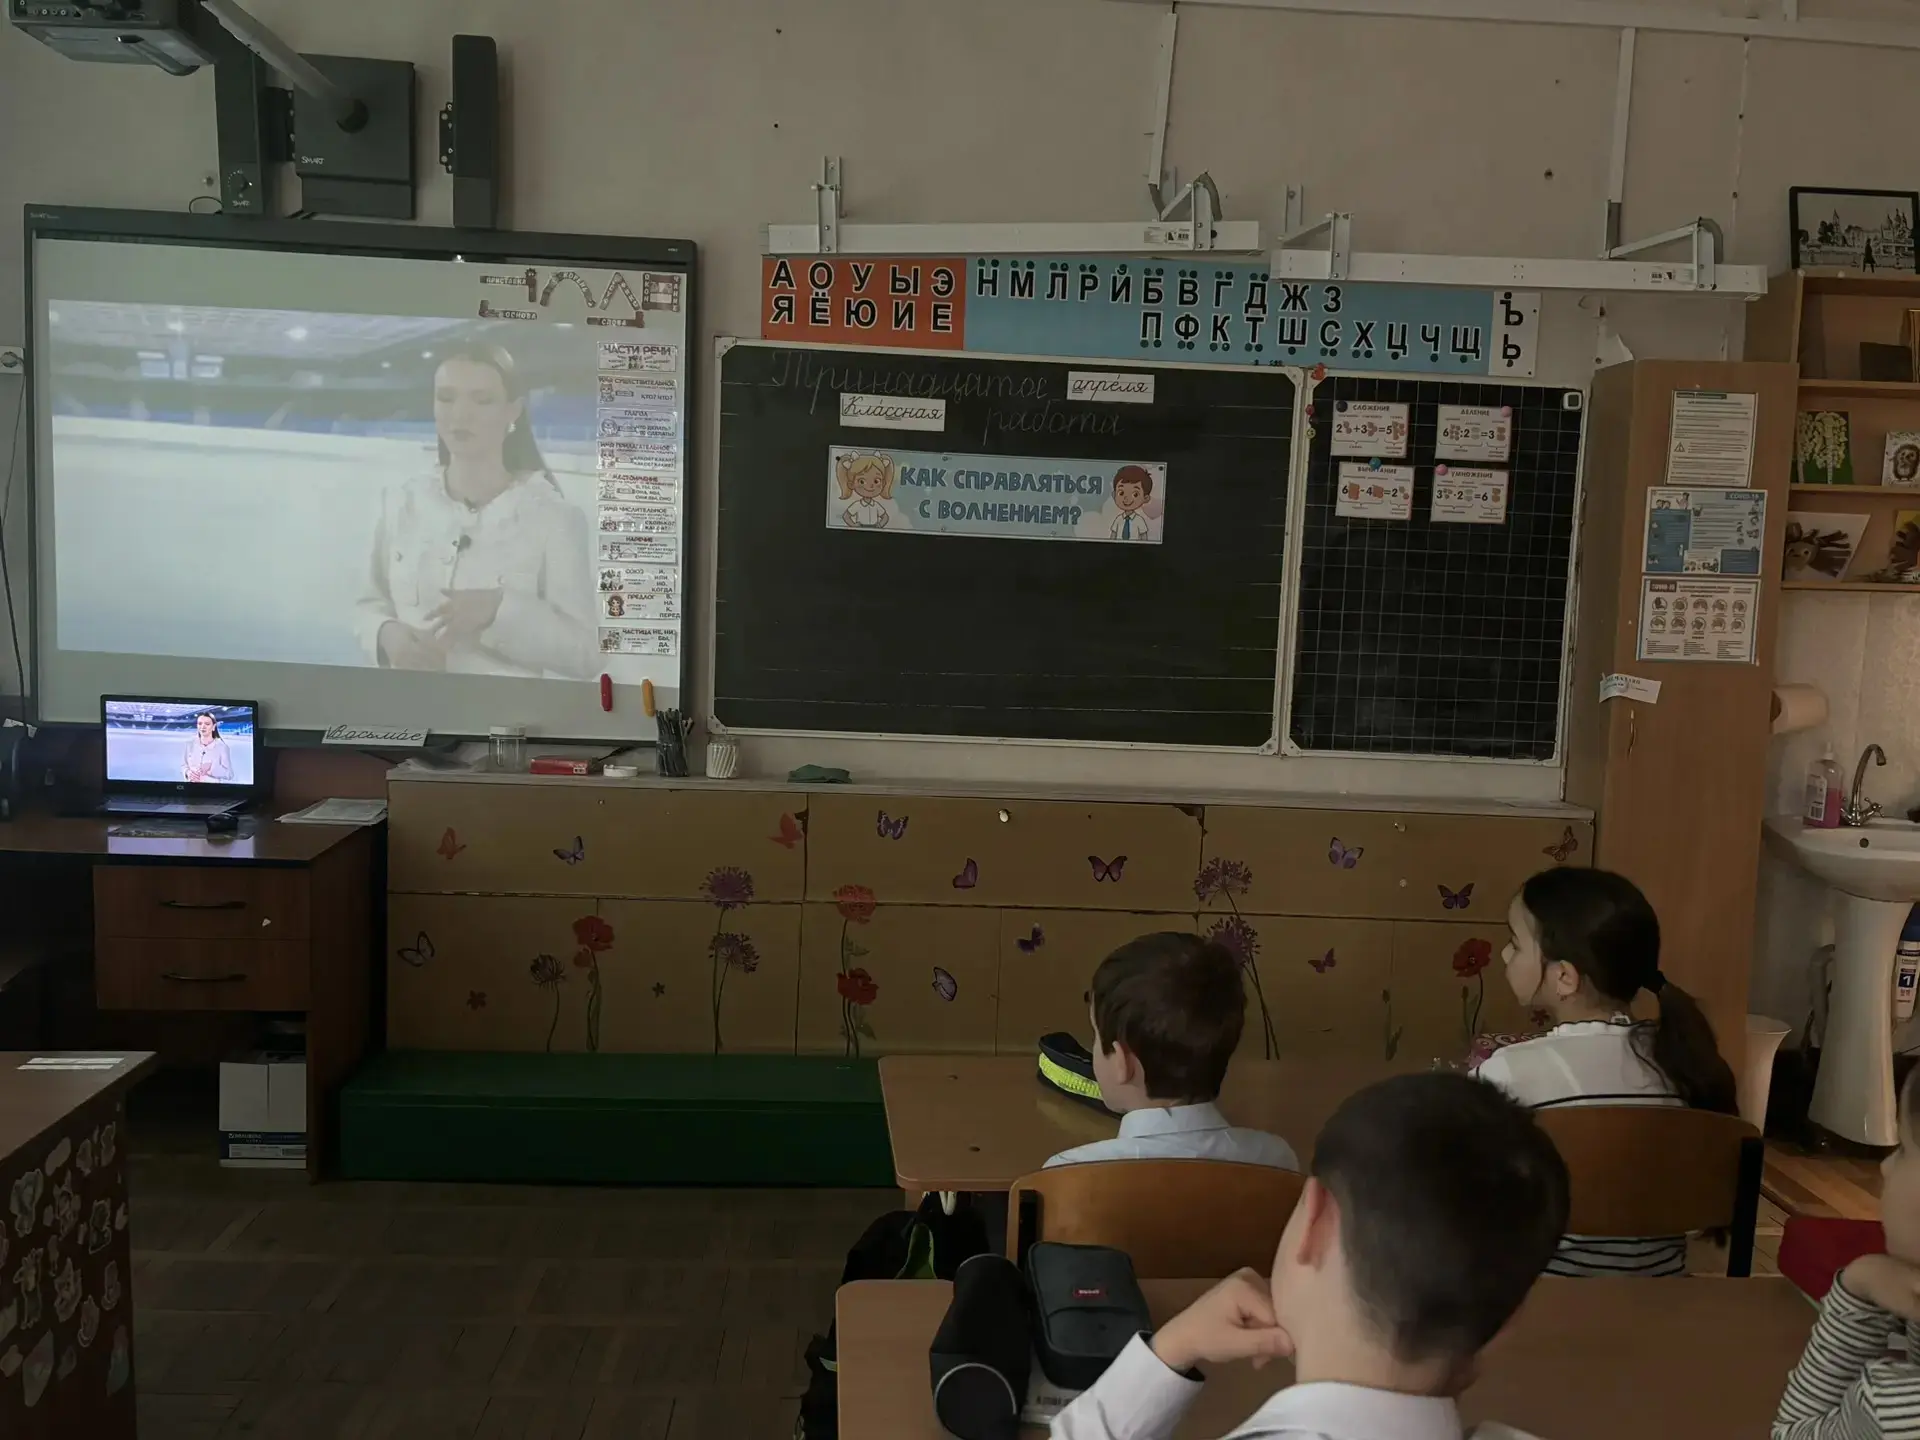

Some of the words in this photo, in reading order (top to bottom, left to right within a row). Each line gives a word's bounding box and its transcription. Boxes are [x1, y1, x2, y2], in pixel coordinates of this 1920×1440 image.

[486, 277, 527, 285] ПРИСТАВКА
[563, 272, 589, 292] КОРЕНЬ
[769, 259, 797, 290] А
[808, 260, 834, 290] О
[850, 262, 875, 293] У
[889, 264, 920, 296] Ы
[931, 266, 955, 297] Э
[976, 267, 999, 298] Н
[1009, 268, 1035, 300] М
[1046, 270, 1068, 301] Л
[1078, 273, 1099, 302] Р
[1110, 264, 1132, 304] Й
[1142, 276, 1164, 305] Б
[1177, 277, 1200, 307] В
[1213, 278, 1234, 308] Г
[1243, 280, 1268, 316] Д
[1279, 282, 1310, 313] Ж
[1322, 285, 1343, 314] З
[505, 311, 537, 319] ОСНОВА
[769, 294, 795, 324] Я
[809, 290, 831, 326] Ё
[844, 297, 877, 329] Ю
[892, 299, 915, 331] И
[931, 301, 952, 333] Е
[1500, 299, 1523, 325] Ъ
[601, 318, 627, 326] СЛОВА
[1140, 310, 1162, 341] П
[1173, 313, 1200, 341] Ф
[1210, 313, 1232, 344] К
[1244, 316, 1265, 345] Т
[1277, 316, 1308, 346] Ш
[1318, 319, 1341, 349] С
[1351, 320, 1377, 350] Х
[1386, 322, 1408, 357] Ц
[1420, 323, 1441, 353] Ч
[1450, 326, 1482, 360] Щ
[604, 345, 640, 354] ЧАСТИ
[643, 346, 671, 355] РЕЧИ
[1502, 334, 1521, 360] Ь
[772, 350, 1048, 415] Тринадцатое
[983, 399, 1125, 447] работа
[1336, 424, 1342, 433] 2
[1443, 428, 1449, 437] 6
[616, 442, 670, 450] ПРИЛАГАТЕЛЬНОЕ
[901, 466, 947, 487] КАК
[953, 469, 1103, 495] СПРАВЛЯТЬСЯ
[1342, 485, 1348, 494] 6
[1436, 490, 1442, 499] 3
[919, 499, 930, 518] С
[937, 500, 1082, 526] ВОЛНЕНИЕМ?
[1902, 976, 1911, 986] 1
